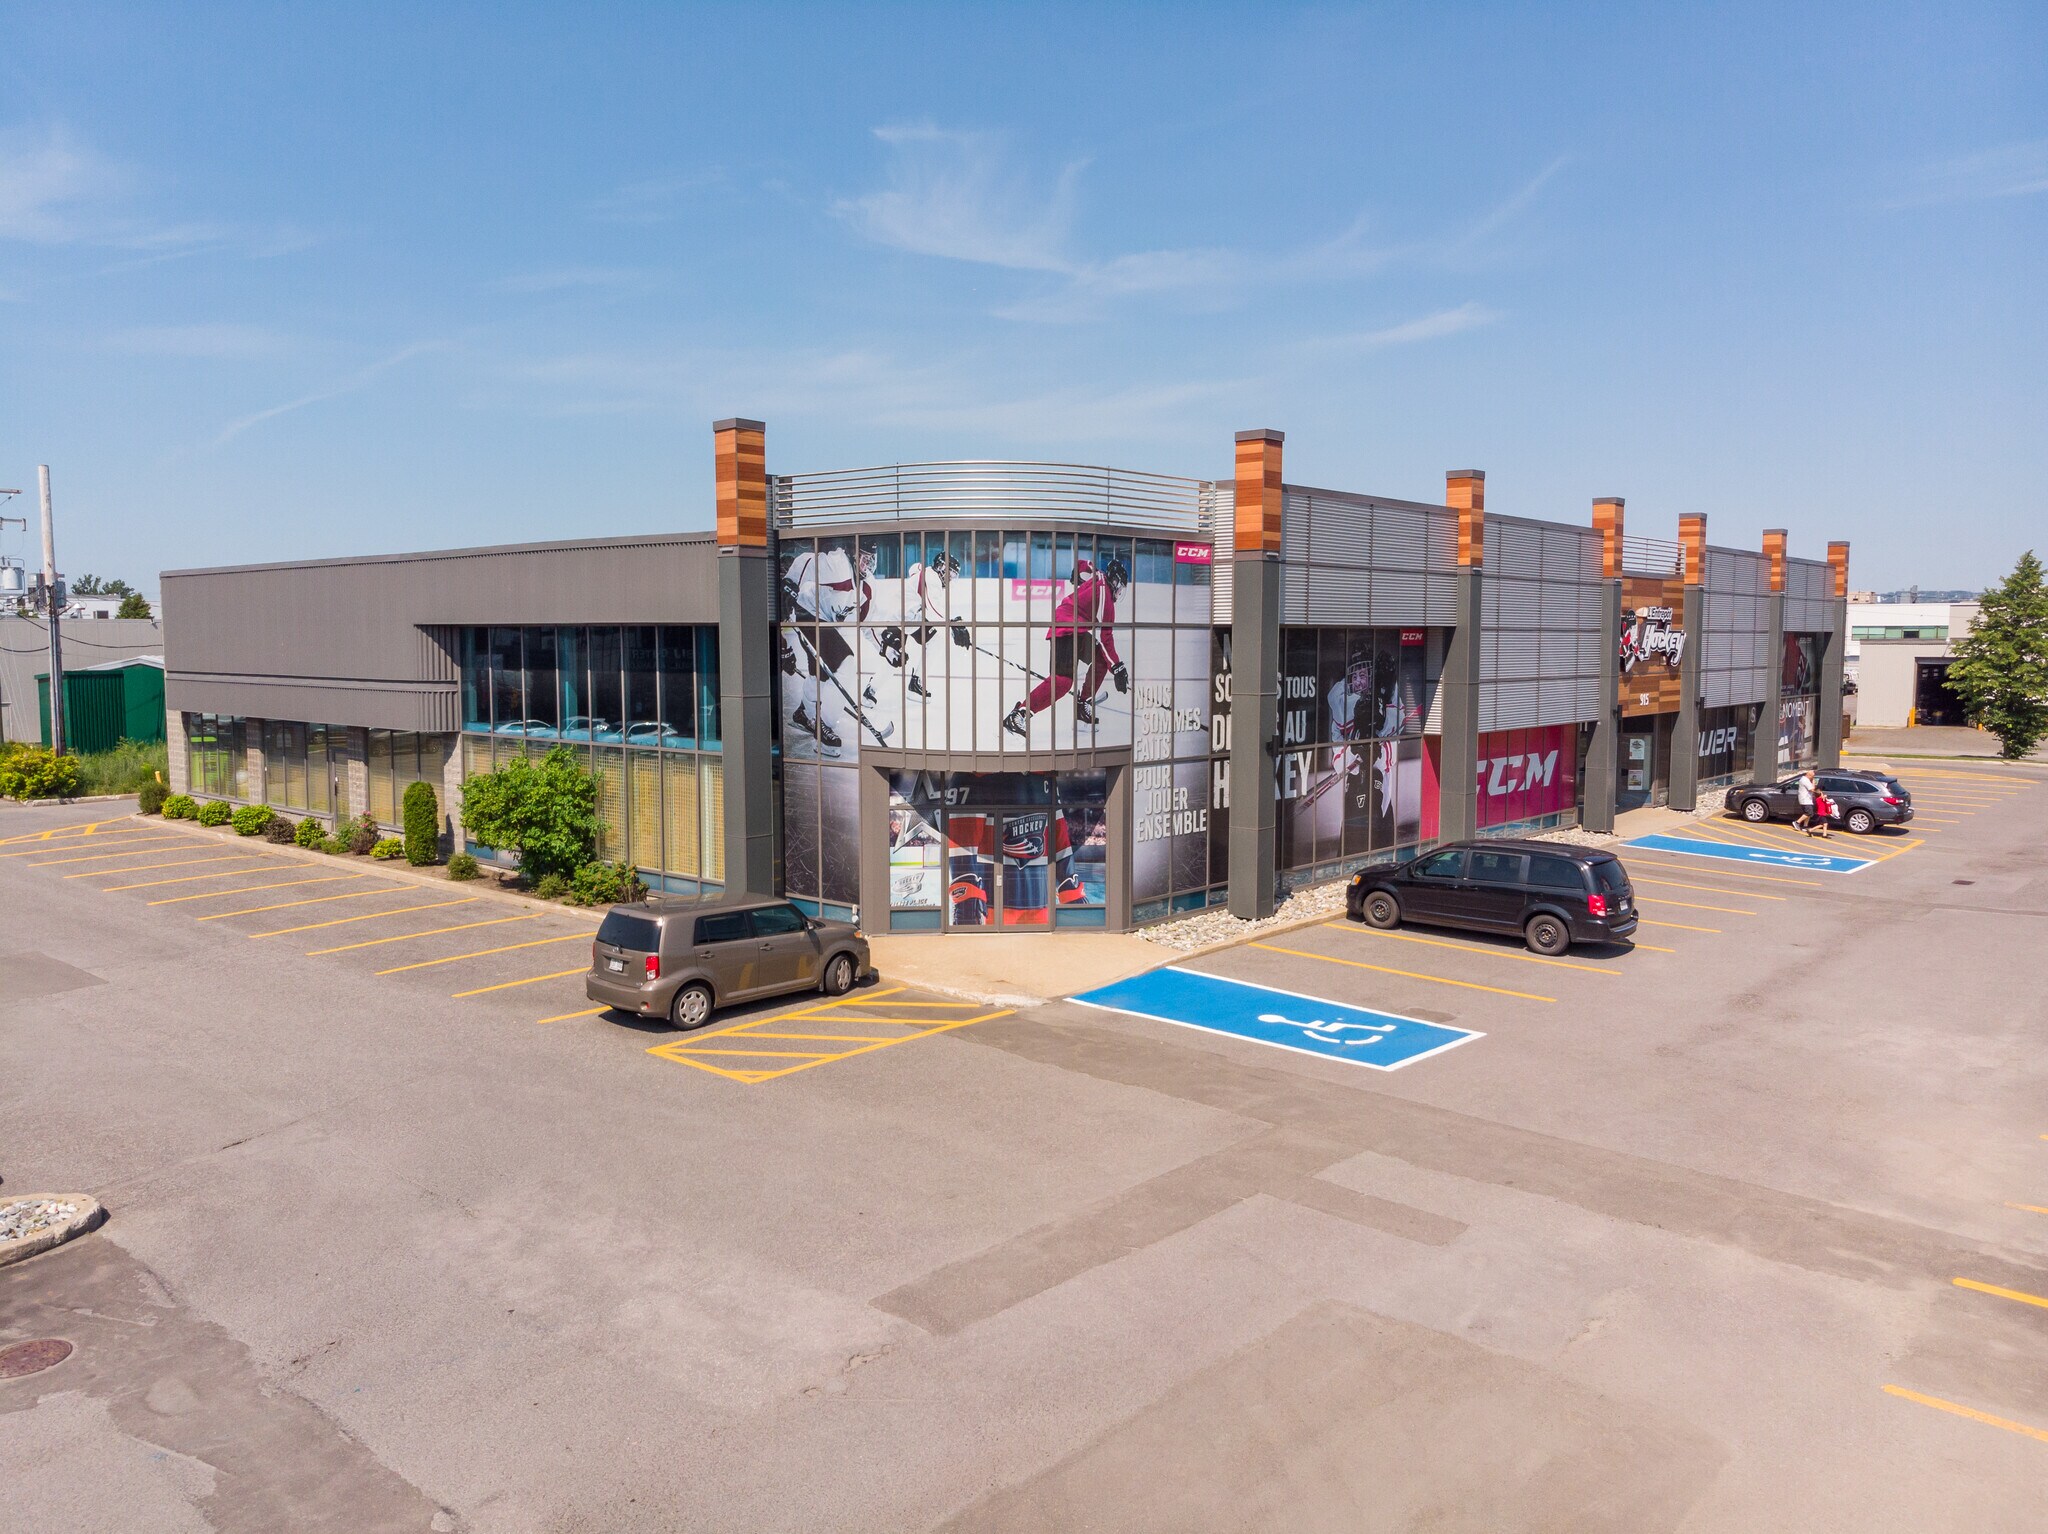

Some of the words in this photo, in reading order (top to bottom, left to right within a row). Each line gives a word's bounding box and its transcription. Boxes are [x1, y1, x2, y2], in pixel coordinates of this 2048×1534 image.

[1177, 546, 1210, 558] CCM
[1401, 632, 1424, 641] CCM
[1641, 620, 1687, 667] Hockey
[1135, 685, 1171, 709] NOUS
[1286, 675, 1316, 699] TOUS
[1640, 694, 1650, 706] 915
[1142, 707, 1202, 735] SOMMES
[1284, 710, 1307, 745] AU
[1134, 737, 1171, 762] FAITS
[1134, 765, 1171, 792] POUR
[1145, 786, 1189, 815] JOUER
[1012, 820, 1044, 838] HOCKEY
[1136, 808, 1207, 843] ENSEMBLE
